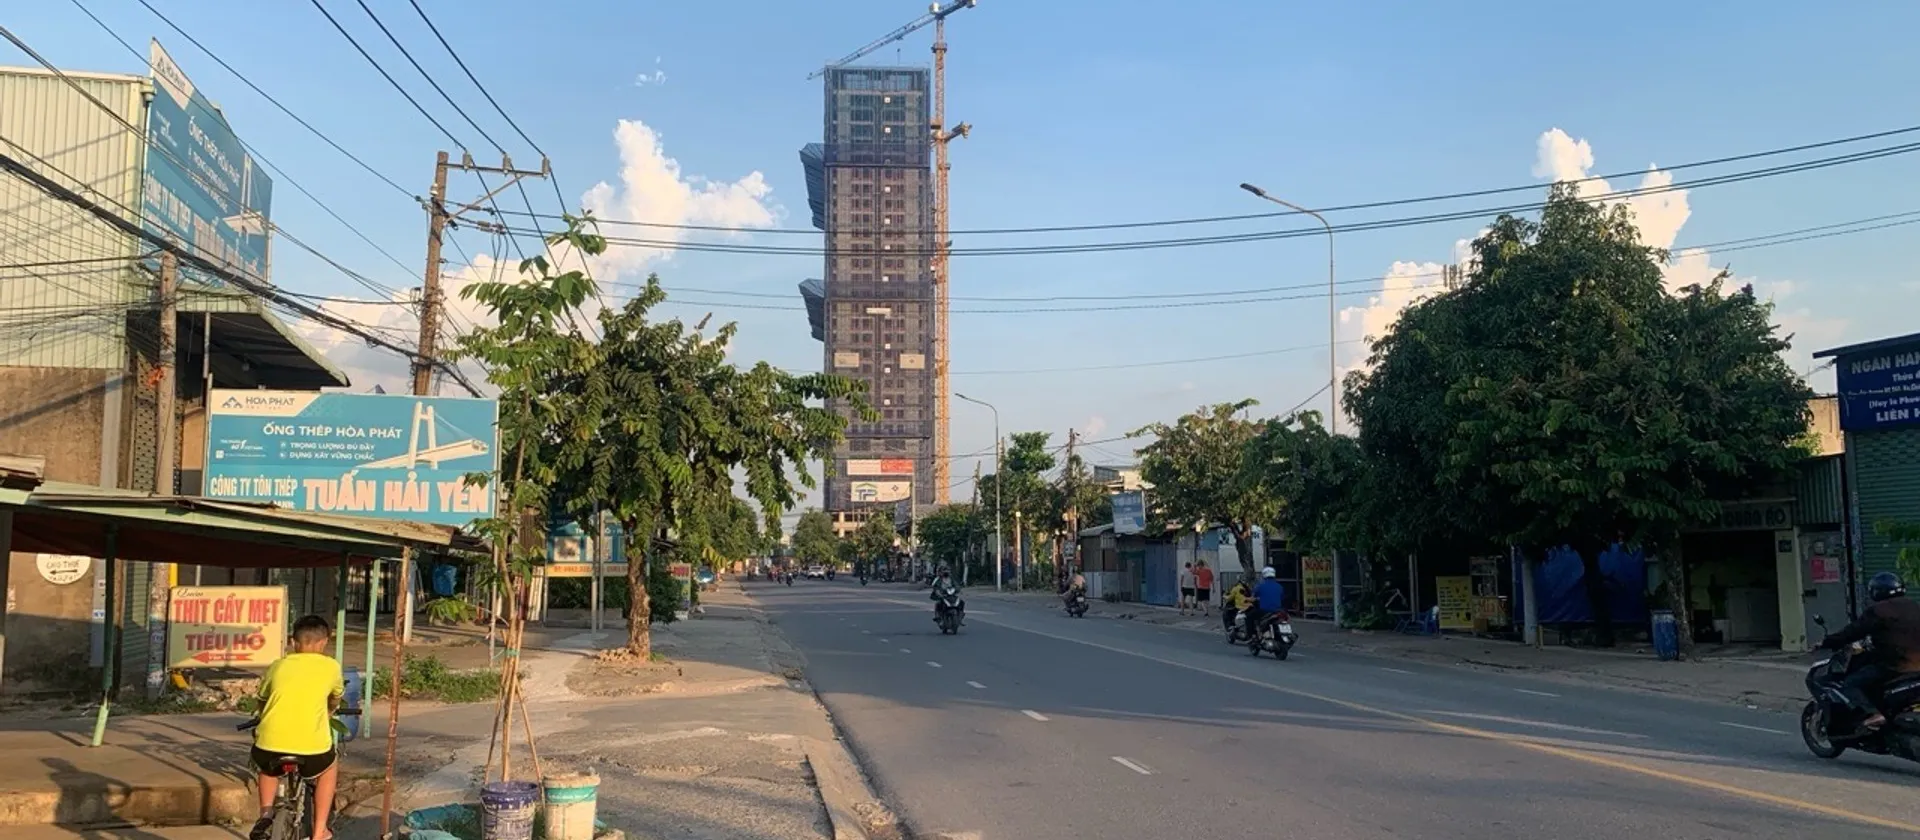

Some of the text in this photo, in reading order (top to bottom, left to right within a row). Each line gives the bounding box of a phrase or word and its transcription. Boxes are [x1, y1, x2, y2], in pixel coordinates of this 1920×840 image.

[263, 421, 403, 440] ỐNG THÉP HÒA PHÁT
[290, 442, 317, 450] TRỌNG
[210, 473, 298, 497] CÔNG TY TÔN THÉP
[303, 469, 375, 511] TUẤN
[383, 471, 429, 512] HẢI
[174, 598, 210, 626] THỊT
[248, 598, 281, 627] MẸT
[185, 625, 266, 651] TIỂU HỔ
